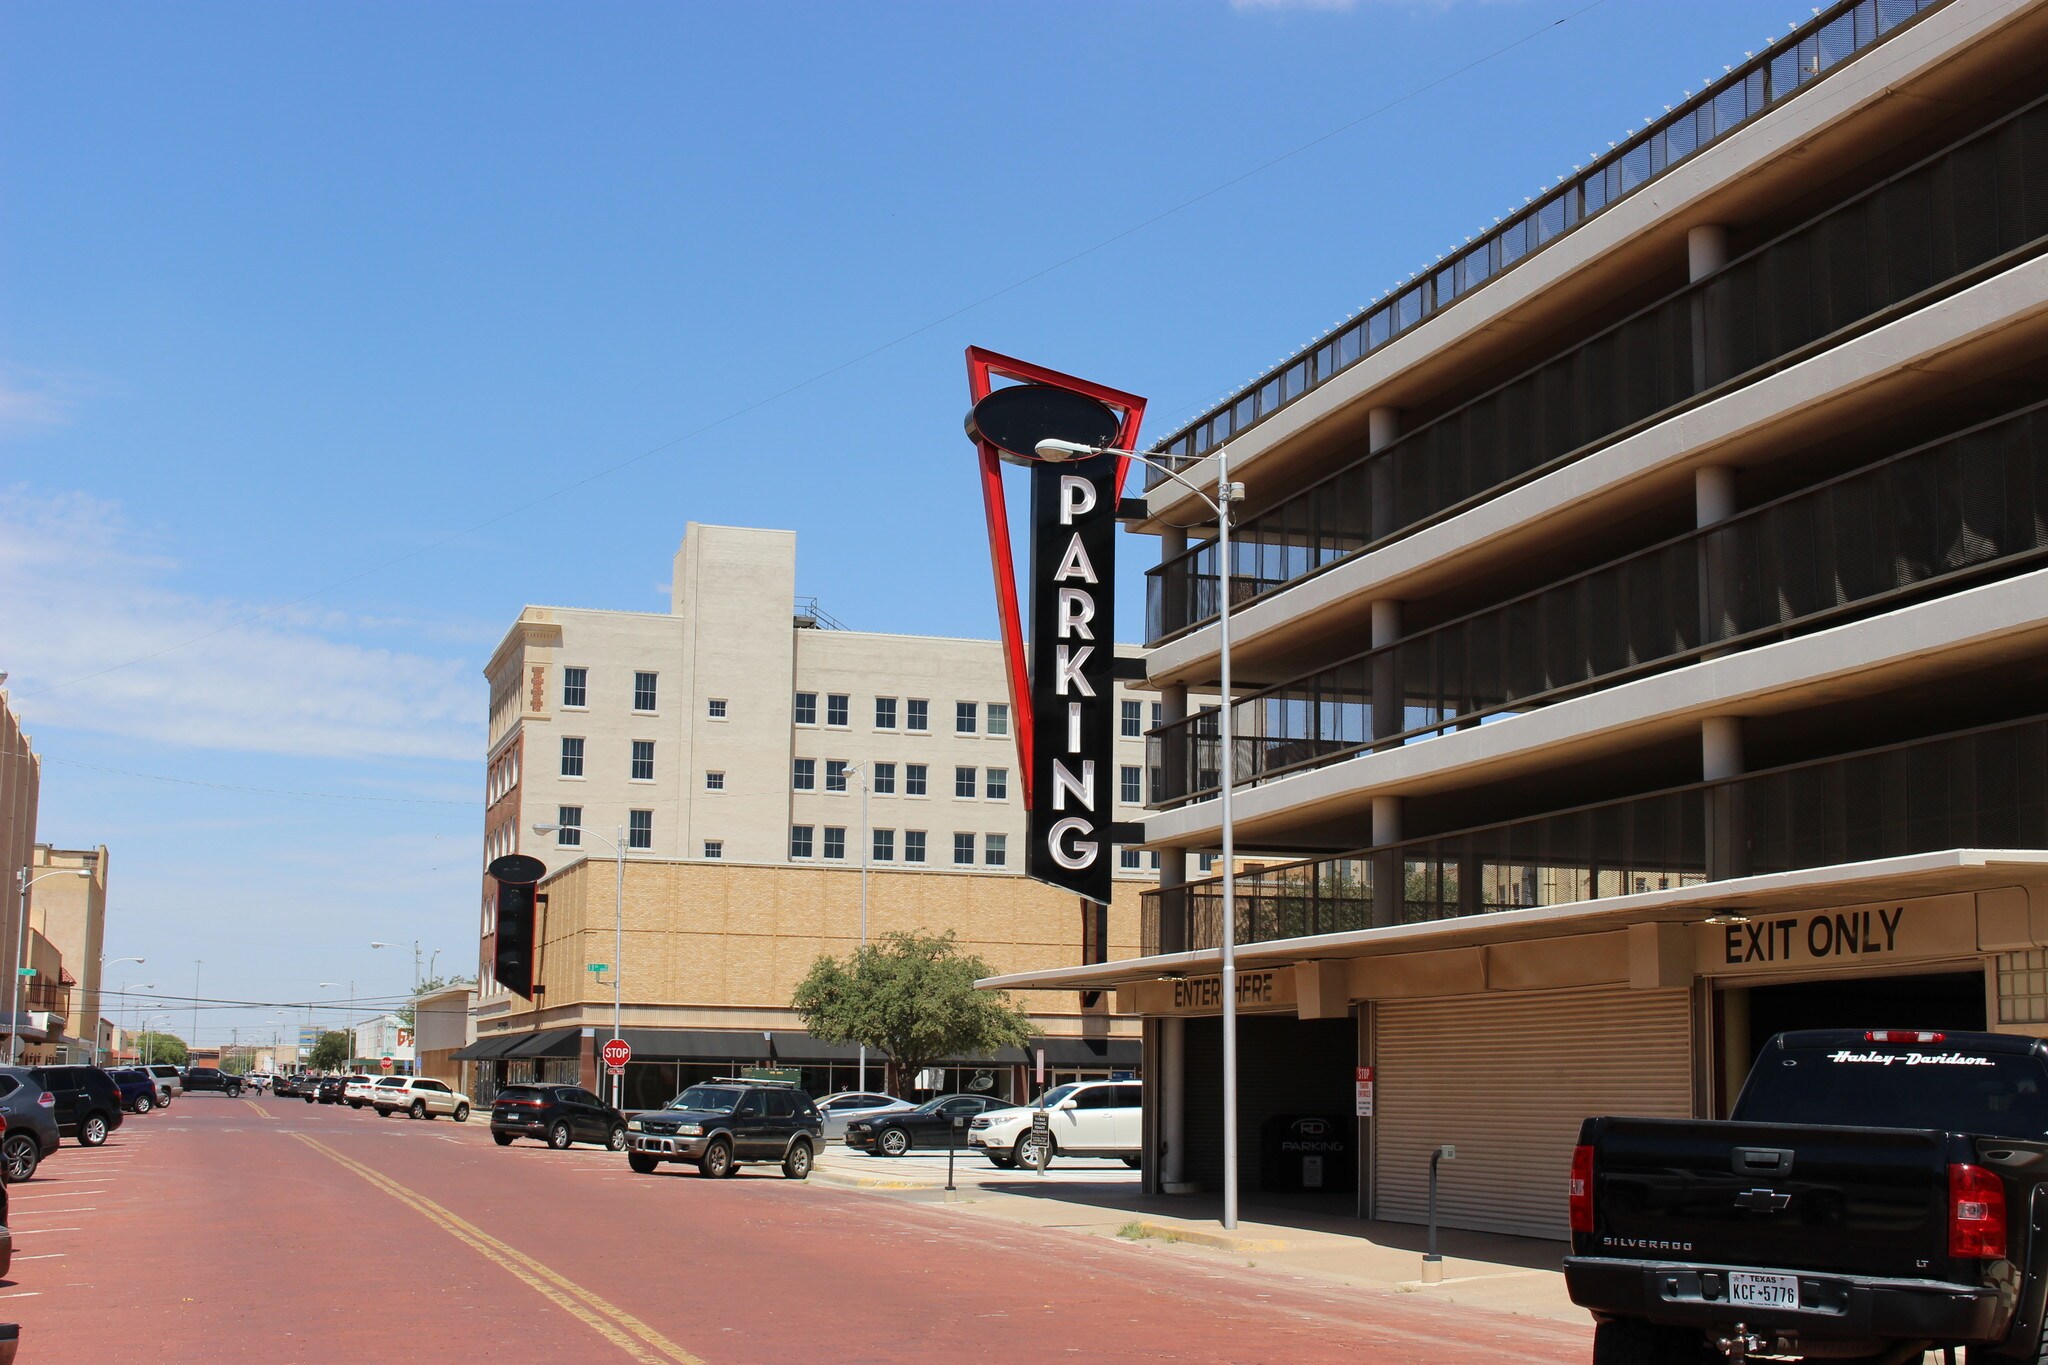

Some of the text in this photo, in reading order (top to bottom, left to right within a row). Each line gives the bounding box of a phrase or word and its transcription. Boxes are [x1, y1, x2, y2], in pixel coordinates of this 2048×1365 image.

[1047, 474, 1099, 870] PARKING
[1725, 907, 1904, 964] EXIT ONLY
[1174, 978, 1220, 1008] ENTER
[605, 1047, 629, 1058] STOP
[1358, 1068, 1370, 1080] STOP
[1282, 1141, 1344, 1152] PARKING
[1603, 1237, 1693, 1251] SILVERADO
[1916, 1259, 1929, 1268] LT
[1749, 1275, 1777, 1283] TEXAS
[1733, 1283, 1794, 1304] KCF 5776
